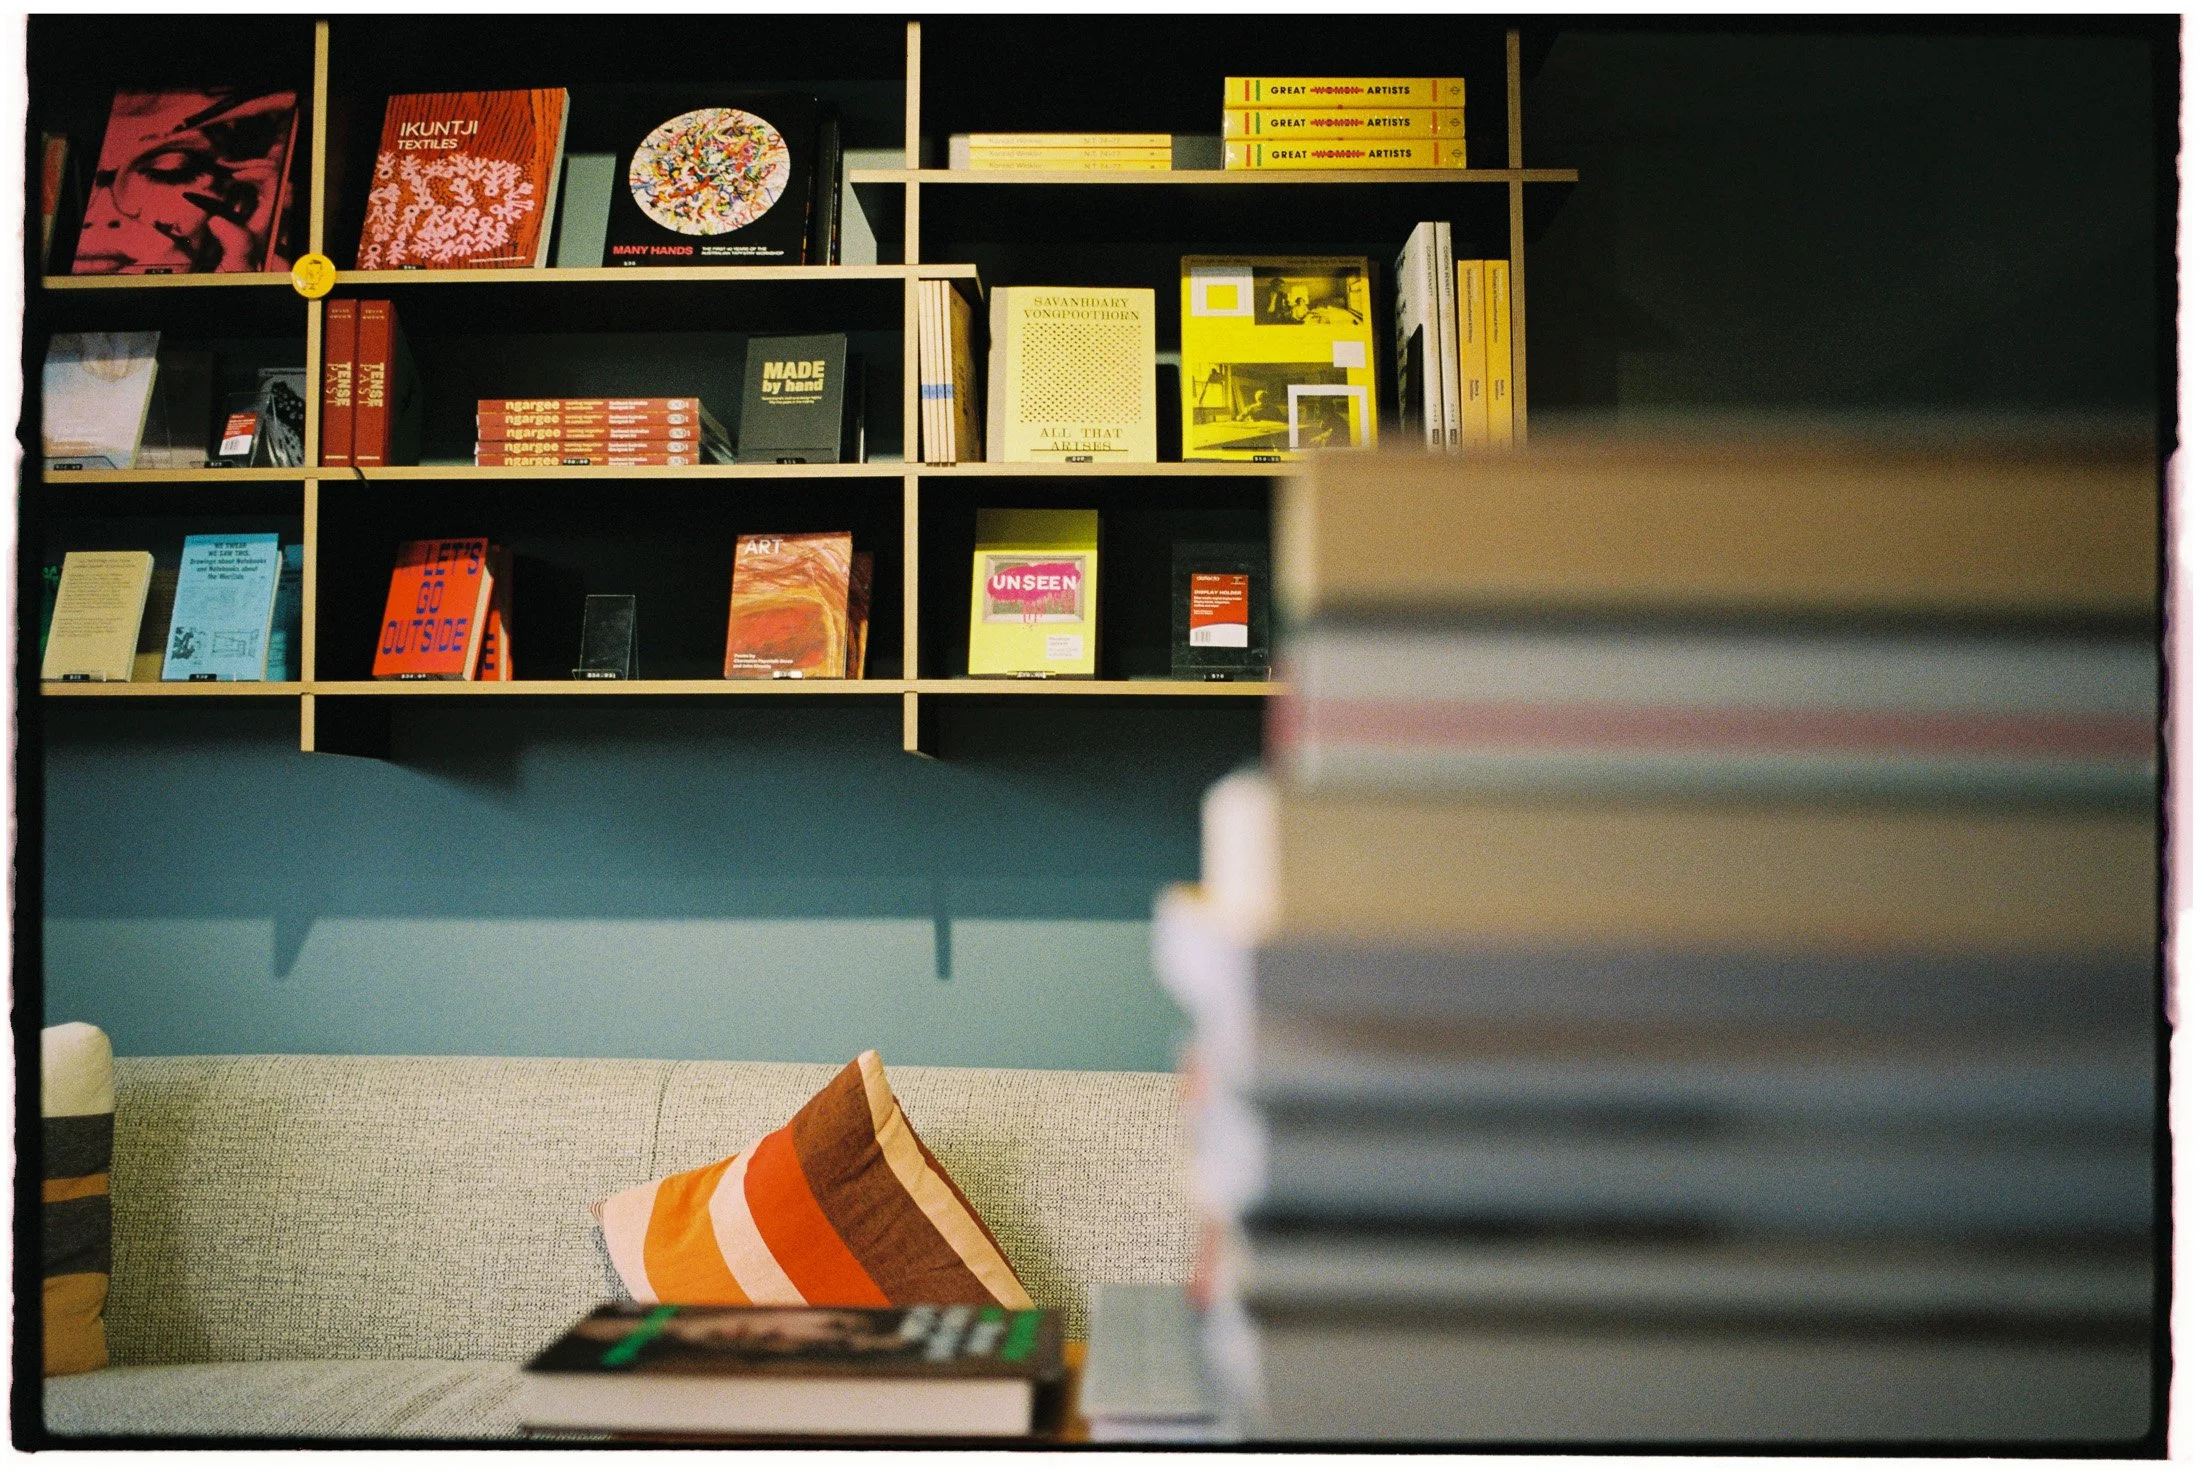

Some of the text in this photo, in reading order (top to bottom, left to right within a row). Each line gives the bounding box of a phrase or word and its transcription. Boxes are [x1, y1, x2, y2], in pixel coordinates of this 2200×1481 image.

[1271, 86, 1306, 95] GREAT
[1367, 86, 1410, 95] ARTISTS
[400, 120, 479, 137] IKUNTJI
[1271, 119, 1306, 127] GREAT
[1367, 119, 1410, 127] ARTISTS
[397, 139, 458, 150] TEXTILES
[1272, 150, 1307, 158] GREAT
[1368, 150, 1411, 158] ARTISTS
[612, 246, 694, 255] MANY HANDS
[1034, 297, 1129, 308] SAVANHDARY
[1024, 309, 1140, 321] VONGPOOTHORN
[763, 360, 825, 380] MADE
[326, 364, 338, 404] PAST
[337, 362, 352, 406] TENSE
[358, 364, 371, 404] PAST
[369, 362, 385, 407] TENSE
[762, 379, 824, 395] by hand
[505, 401, 560, 412] ngargee
[505, 415, 560, 426] ngargee
[506, 428, 561, 440] ngargee
[1040, 428, 1123, 438] ALL THAT
[504, 443, 559, 454] ngargee
[1052, 441, 1112, 451] ARISES
[744, 539, 784, 555] ART
[424, 542, 483, 577] LET'S
[992, 574, 1077, 591] UNSEEN
[416, 581, 445, 615] GO
[382, 618, 468, 655] OUTSIDE
